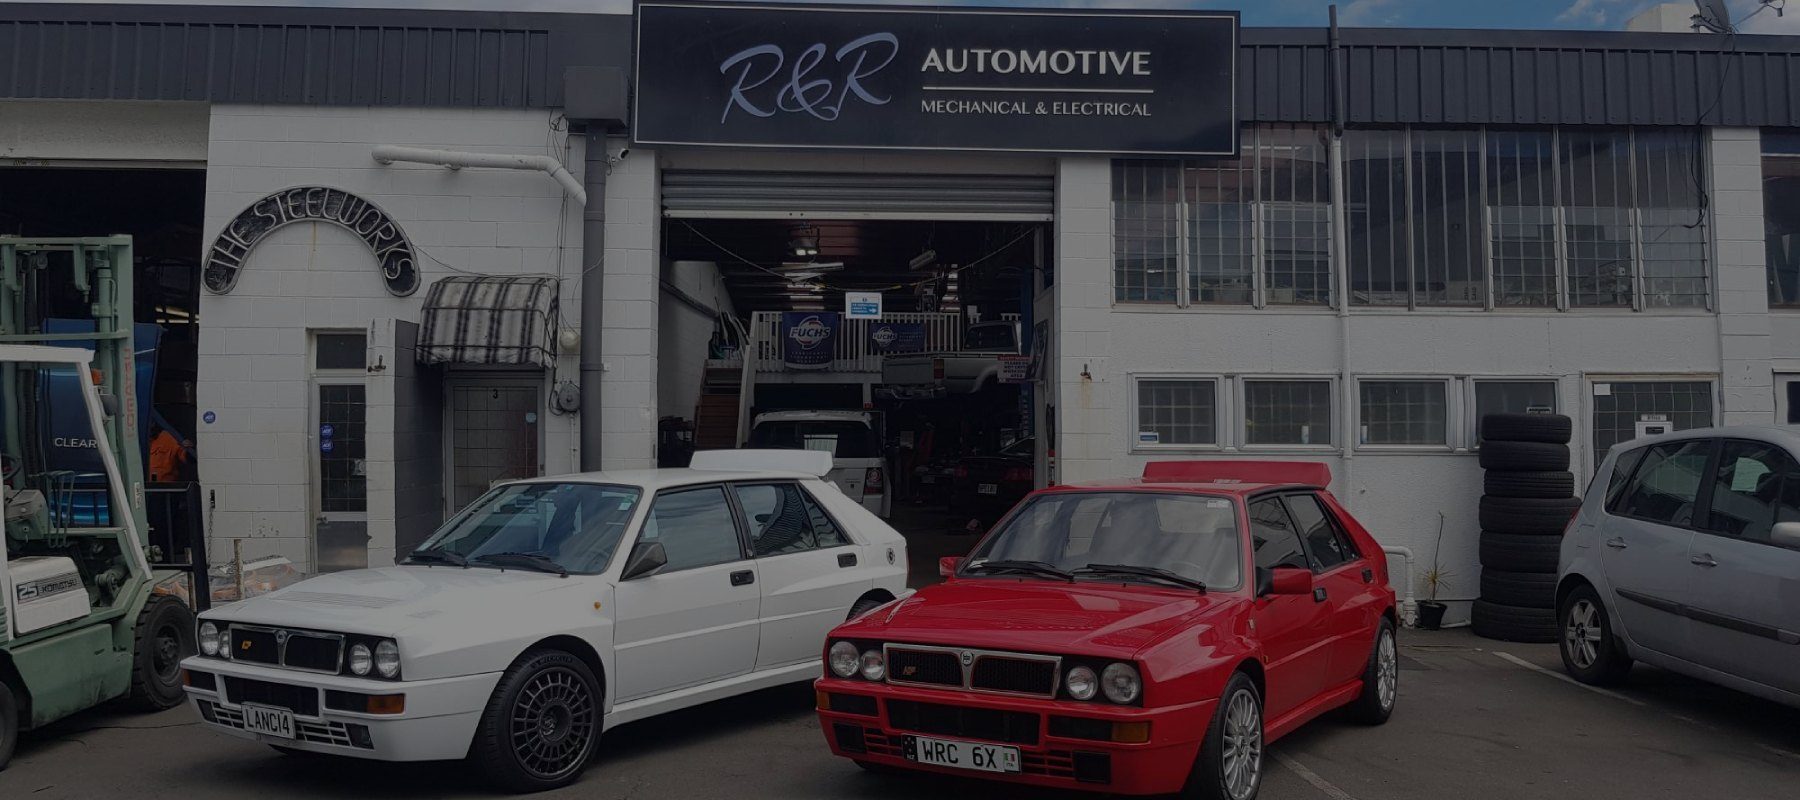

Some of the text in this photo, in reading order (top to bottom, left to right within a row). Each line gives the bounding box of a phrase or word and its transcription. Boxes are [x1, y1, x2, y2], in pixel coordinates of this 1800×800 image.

[921, 47, 1152, 77] AUTOMOTIVE
[719, 32, 899, 125] R&R
[921, 99, 1152, 118] MECHANICAL & ELECTRICAL
[206, 188, 415, 280] THE STEELWORKS
[790, 327, 831, 338] FUCHS
[492, 388, 499, 399] 3
[922, 740, 997, 769] WRC 6X
